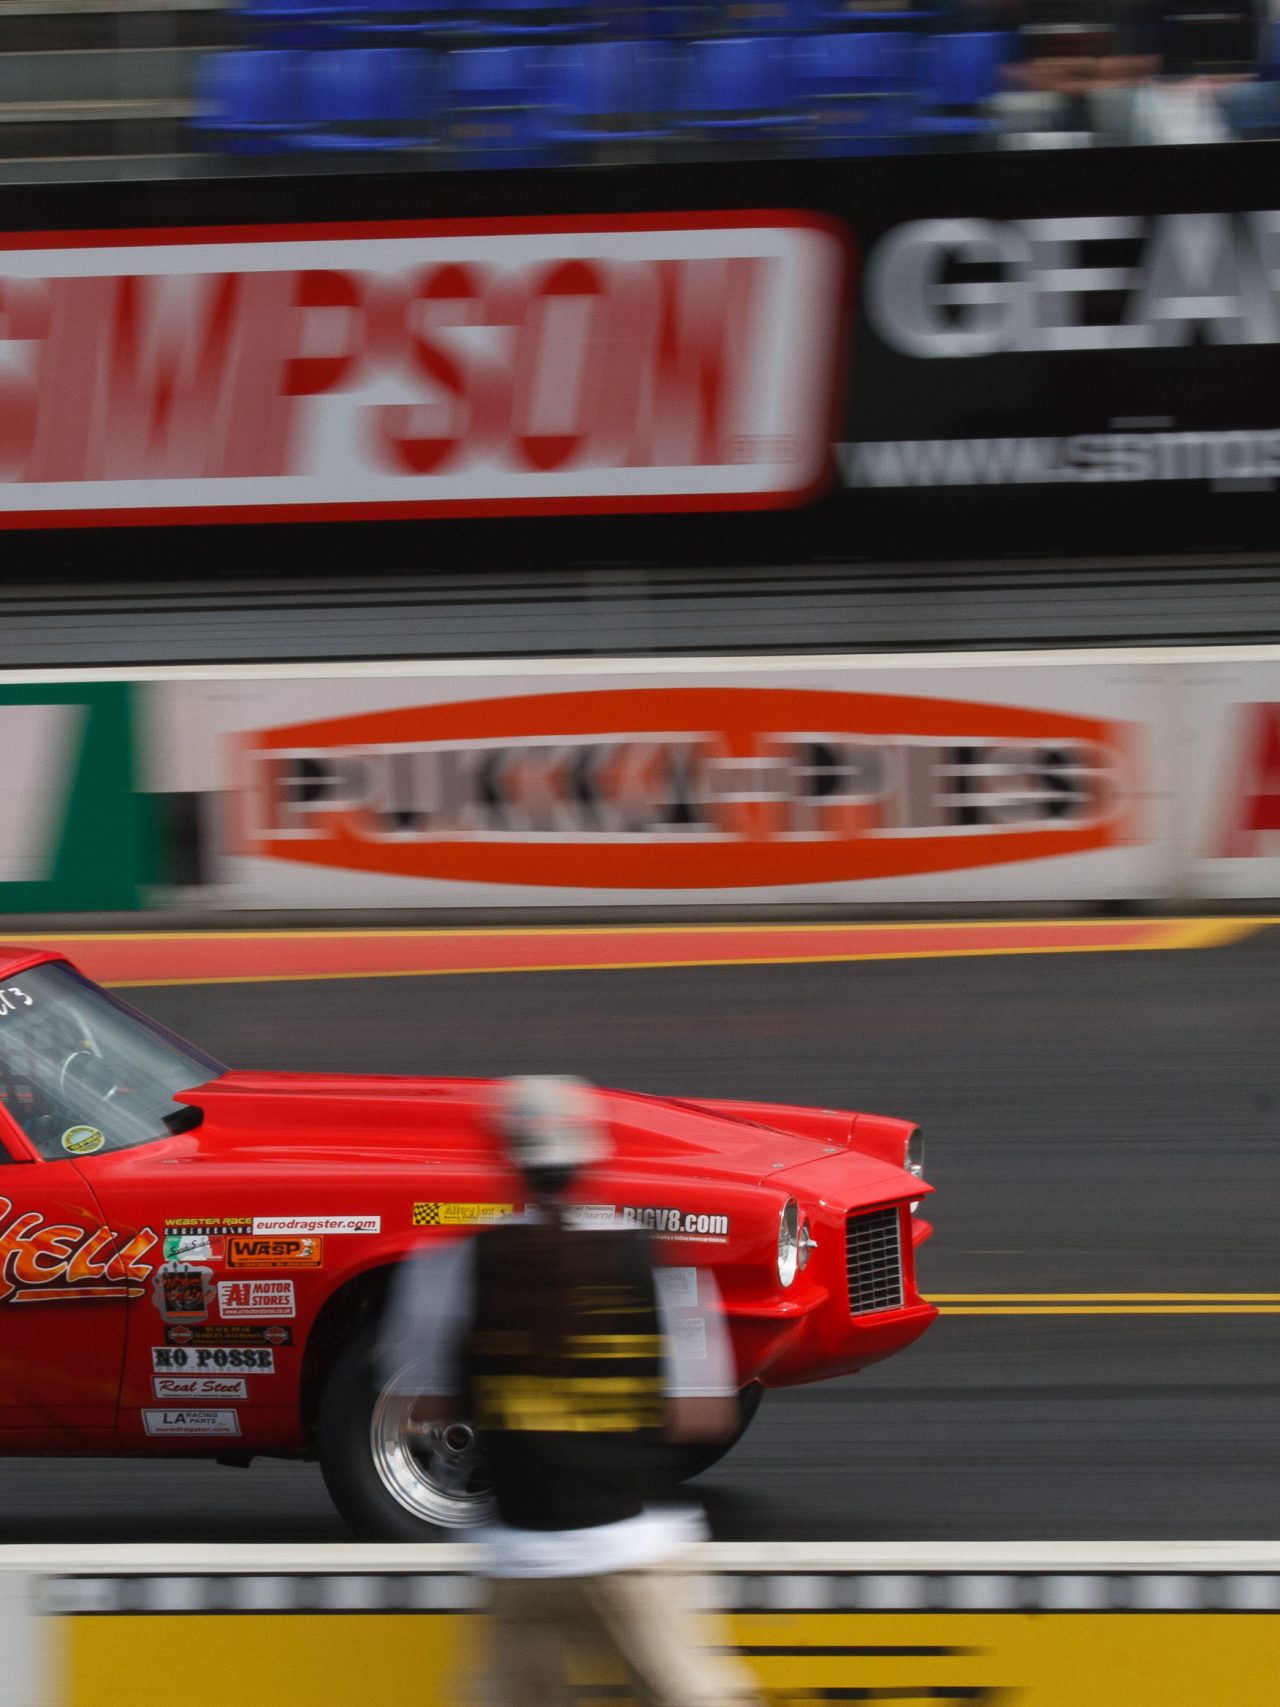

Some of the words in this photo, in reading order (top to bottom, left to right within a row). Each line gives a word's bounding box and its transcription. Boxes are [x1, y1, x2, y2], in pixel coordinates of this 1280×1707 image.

[223, 1217, 252, 1226] RACE
[256, 1217, 376, 1231] eurodragster.com
[234, 1241, 301, 1256] WASP
[252, 1283, 291, 1294] MOTOR
[252, 1296, 290, 1306] STORES
[154, 1348, 188, 1367] NO
[195, 1349, 272, 1368] POSSE
[159, 1380, 198, 1392] Real
[201, 1381, 242, 1392] Steel
[163, 1413, 186, 1424] LA
